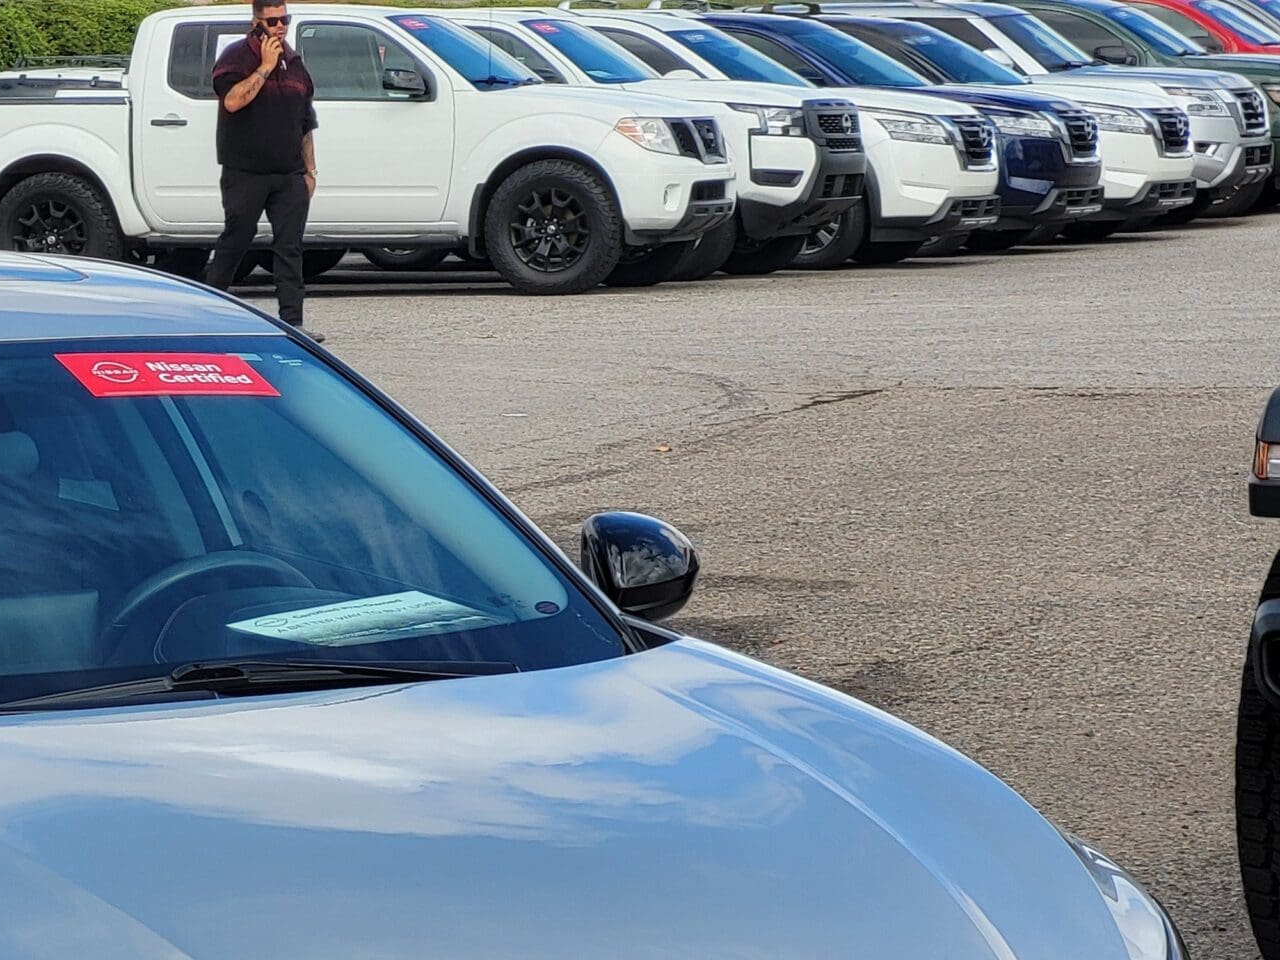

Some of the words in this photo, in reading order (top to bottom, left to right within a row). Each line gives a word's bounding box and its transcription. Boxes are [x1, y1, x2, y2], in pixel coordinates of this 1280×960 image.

[91, 368, 139, 376] NISSAN
[145, 361, 222, 373] Nissan
[158, 372, 253, 384] Certified
